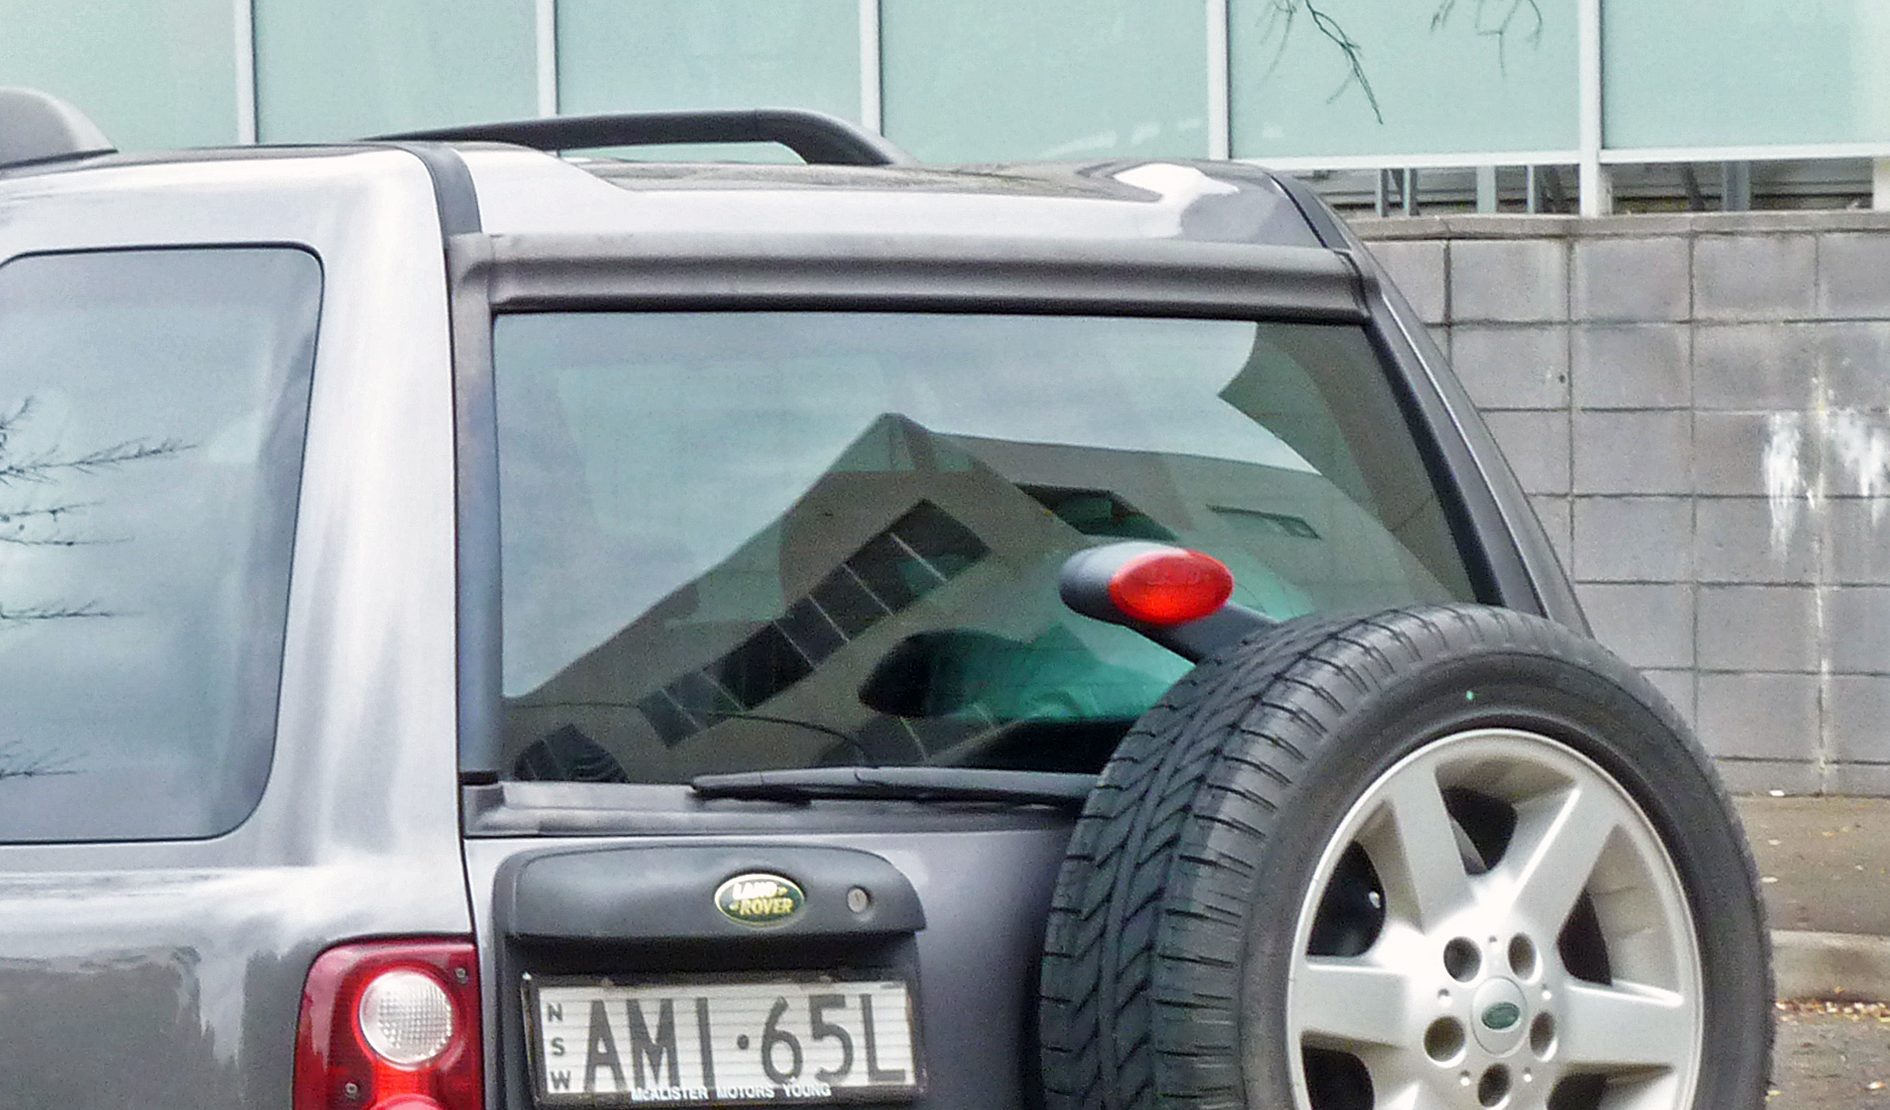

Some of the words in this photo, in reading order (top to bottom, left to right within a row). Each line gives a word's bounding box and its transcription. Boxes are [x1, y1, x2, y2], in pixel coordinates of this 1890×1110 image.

[732, 881, 777, 901] LAND
[740, 897, 794, 916] ROVER
[714, 1083, 775, 1099] MOTORS
[782, 1080, 832, 1097] YOUNG
